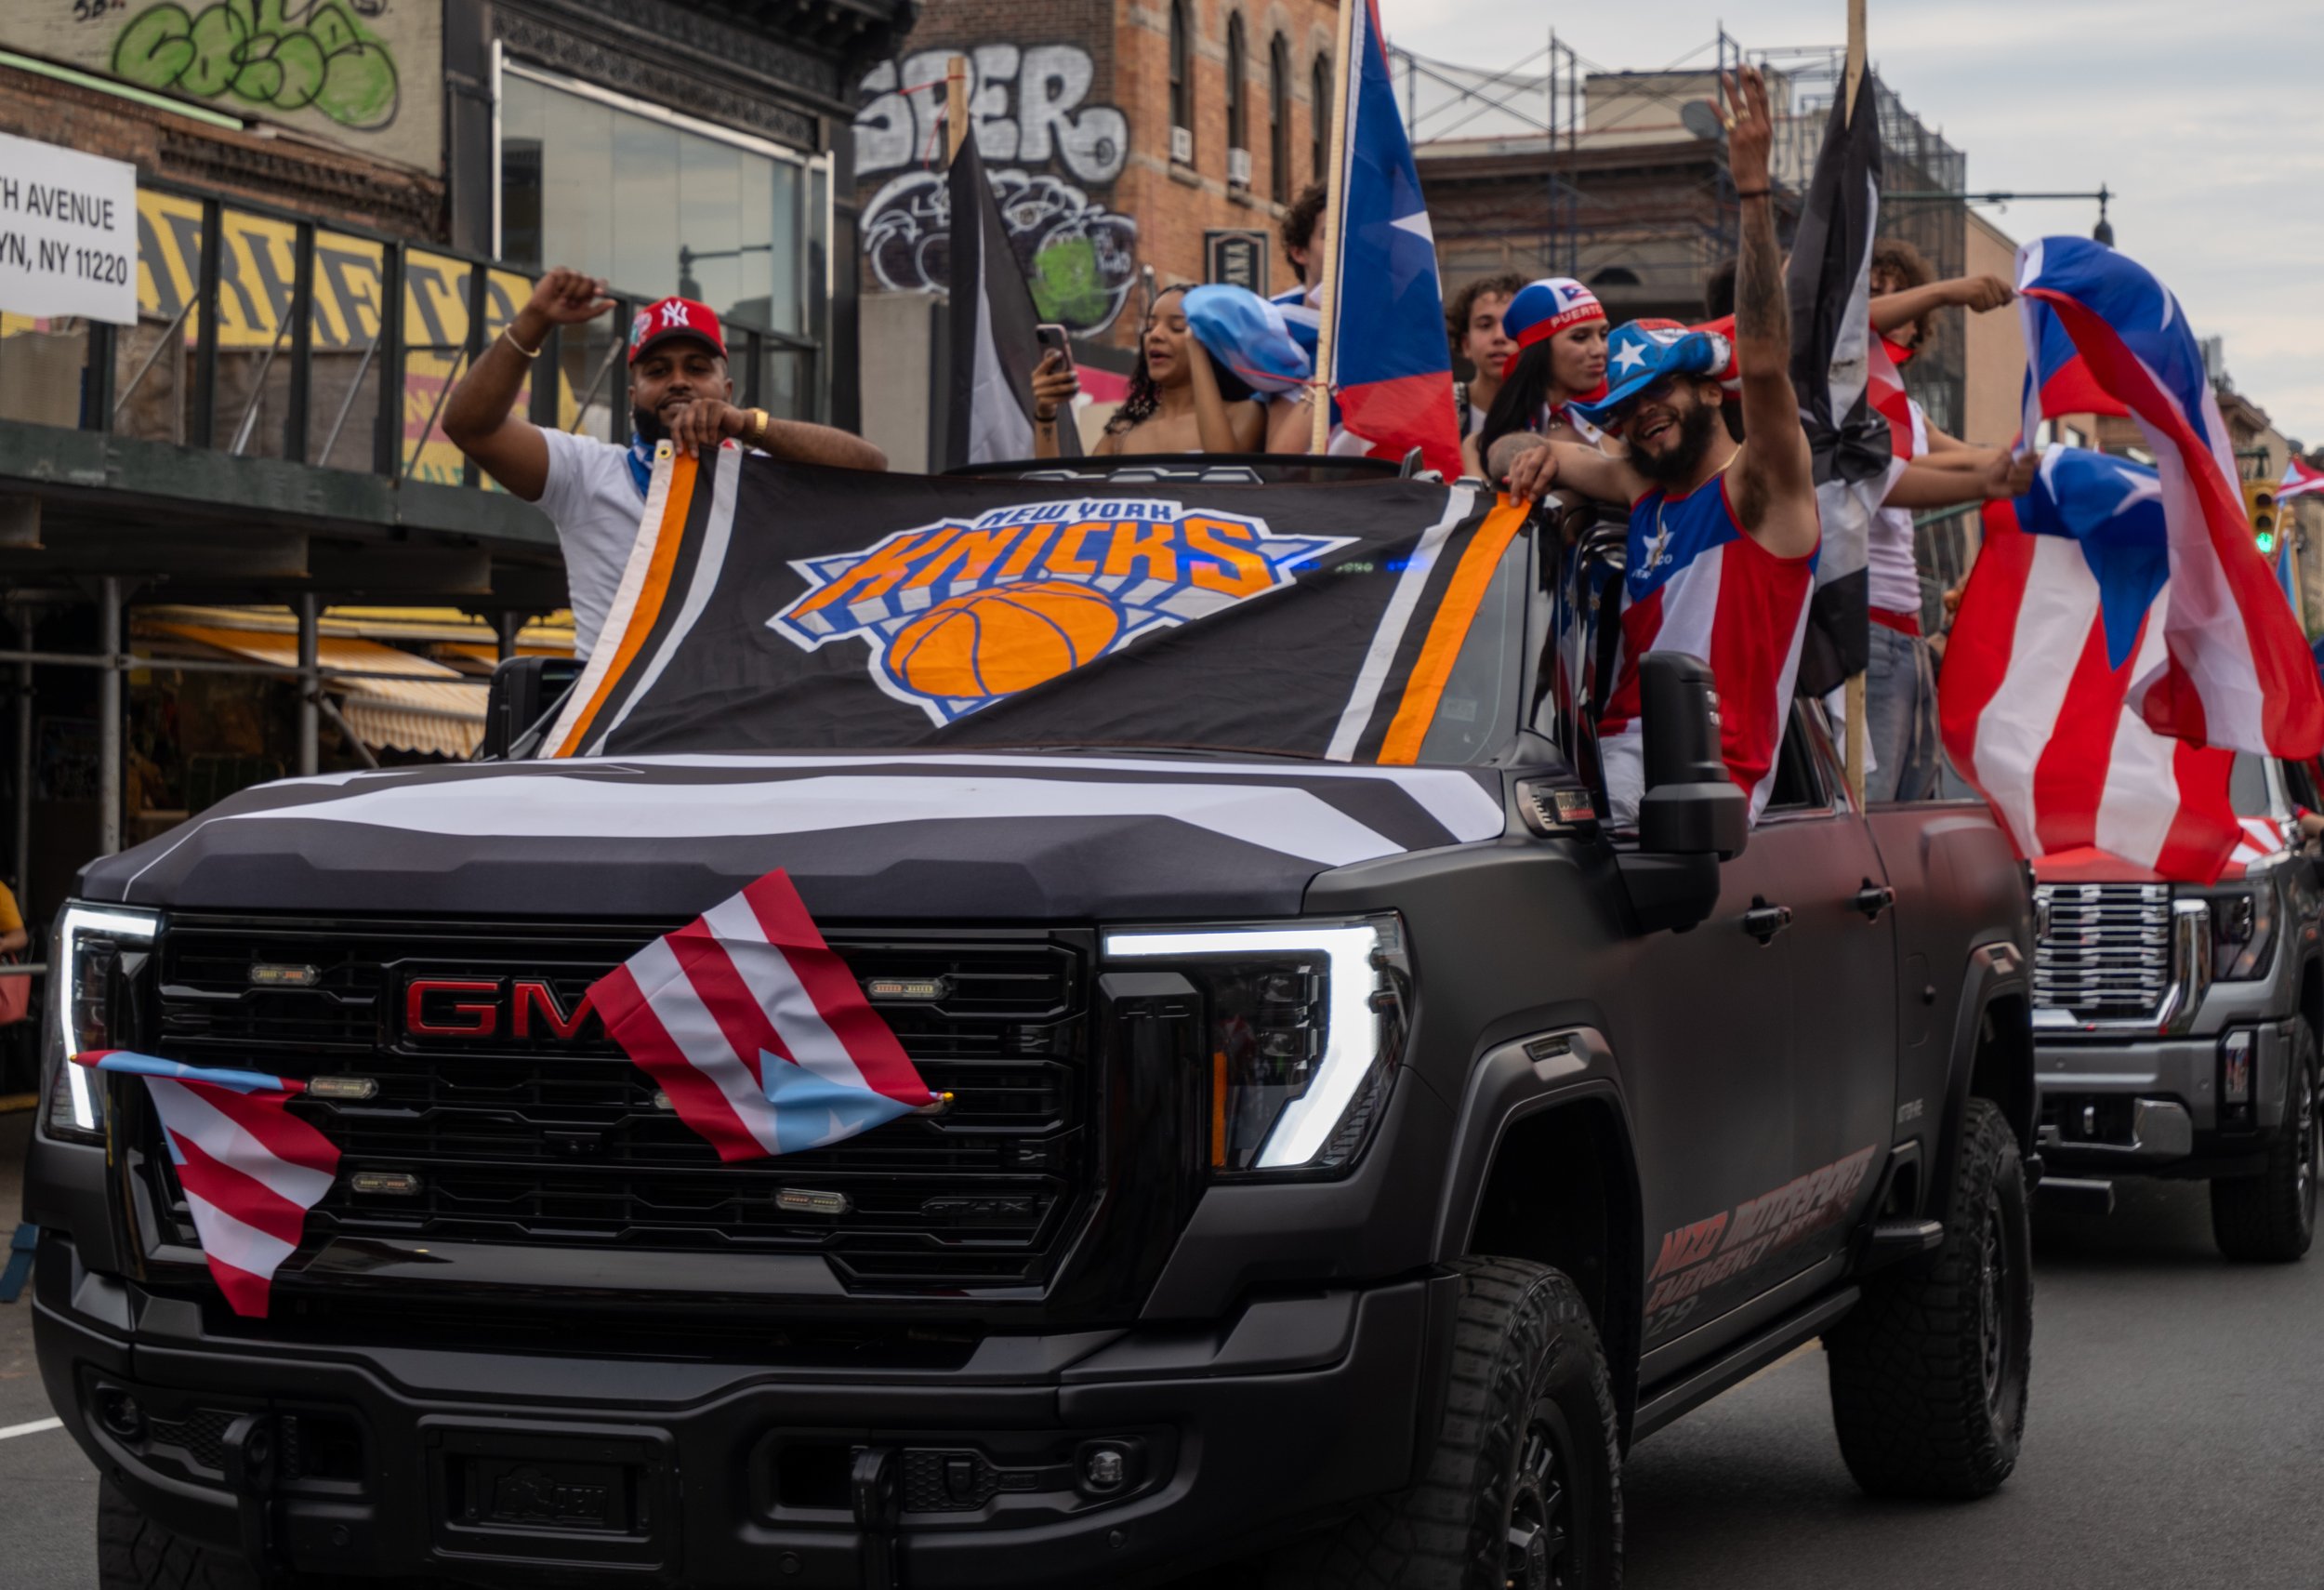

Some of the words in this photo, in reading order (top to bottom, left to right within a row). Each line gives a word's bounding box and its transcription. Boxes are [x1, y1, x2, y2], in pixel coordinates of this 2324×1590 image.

[0, 176, 19, 211] H
[26, 182, 114, 232] AVENUE
[40, 237, 70, 274] NY
[76, 247, 127, 286] 11220
[138, 207, 456, 362] ARKET
[977, 503, 1070, 528] NEW
[1077, 501, 1172, 523] YORK
[788, 516, 1274, 623] KNICKS
[406, 979, 616, 1040] GM
